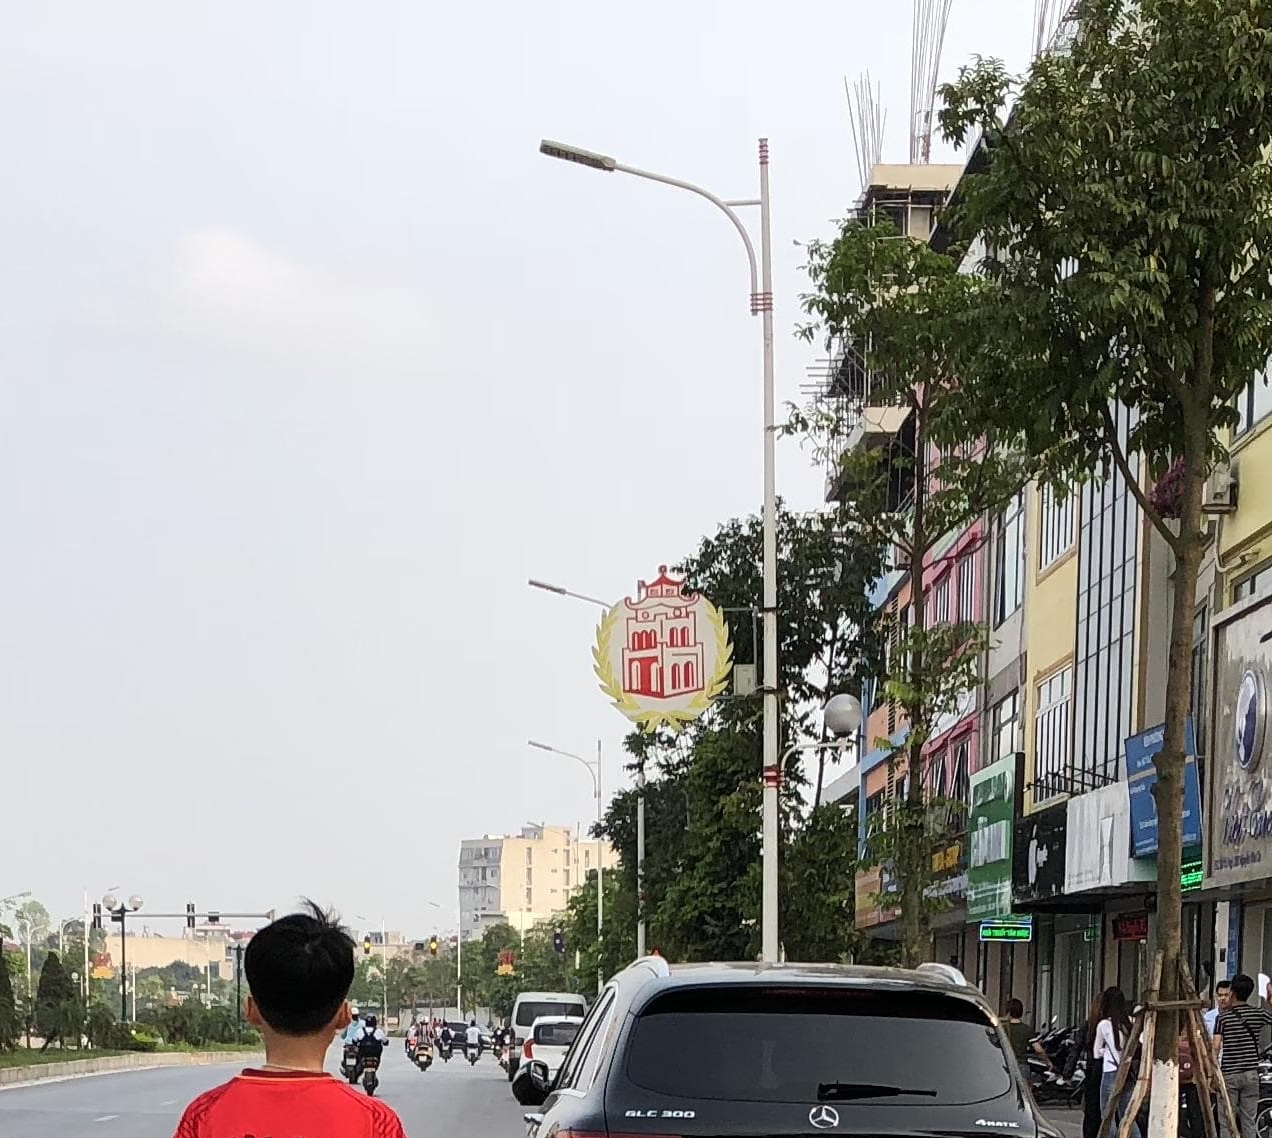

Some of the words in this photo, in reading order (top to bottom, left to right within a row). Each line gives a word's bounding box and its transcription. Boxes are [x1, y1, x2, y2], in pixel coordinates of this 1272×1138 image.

[625, 1110, 657, 1118] GLC
[661, 1110, 695, 1119] 300
[975, 1119, 1019, 1128] 4MATIC
